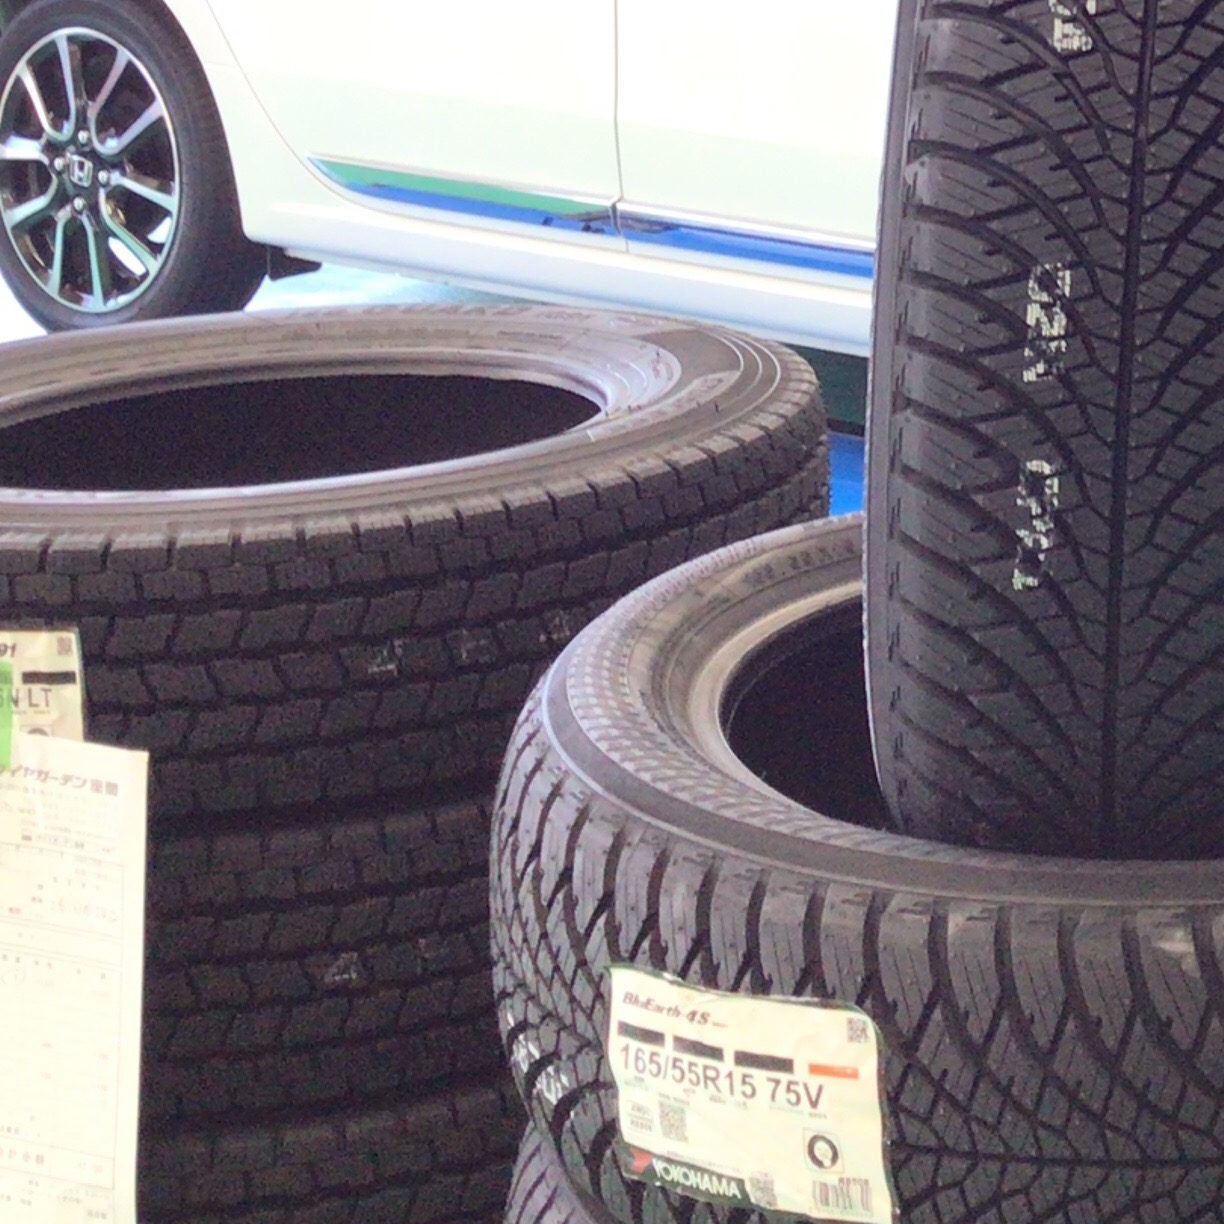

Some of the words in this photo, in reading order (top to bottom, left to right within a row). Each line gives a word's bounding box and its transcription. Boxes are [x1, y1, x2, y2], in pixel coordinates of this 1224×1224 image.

[27, 686, 53, 708] LT
[619, 1043, 757, 1100] 165/55R15
[766, 1077, 824, 1110] 75V
[652, 1158, 742, 1199] YOKOHAMA
